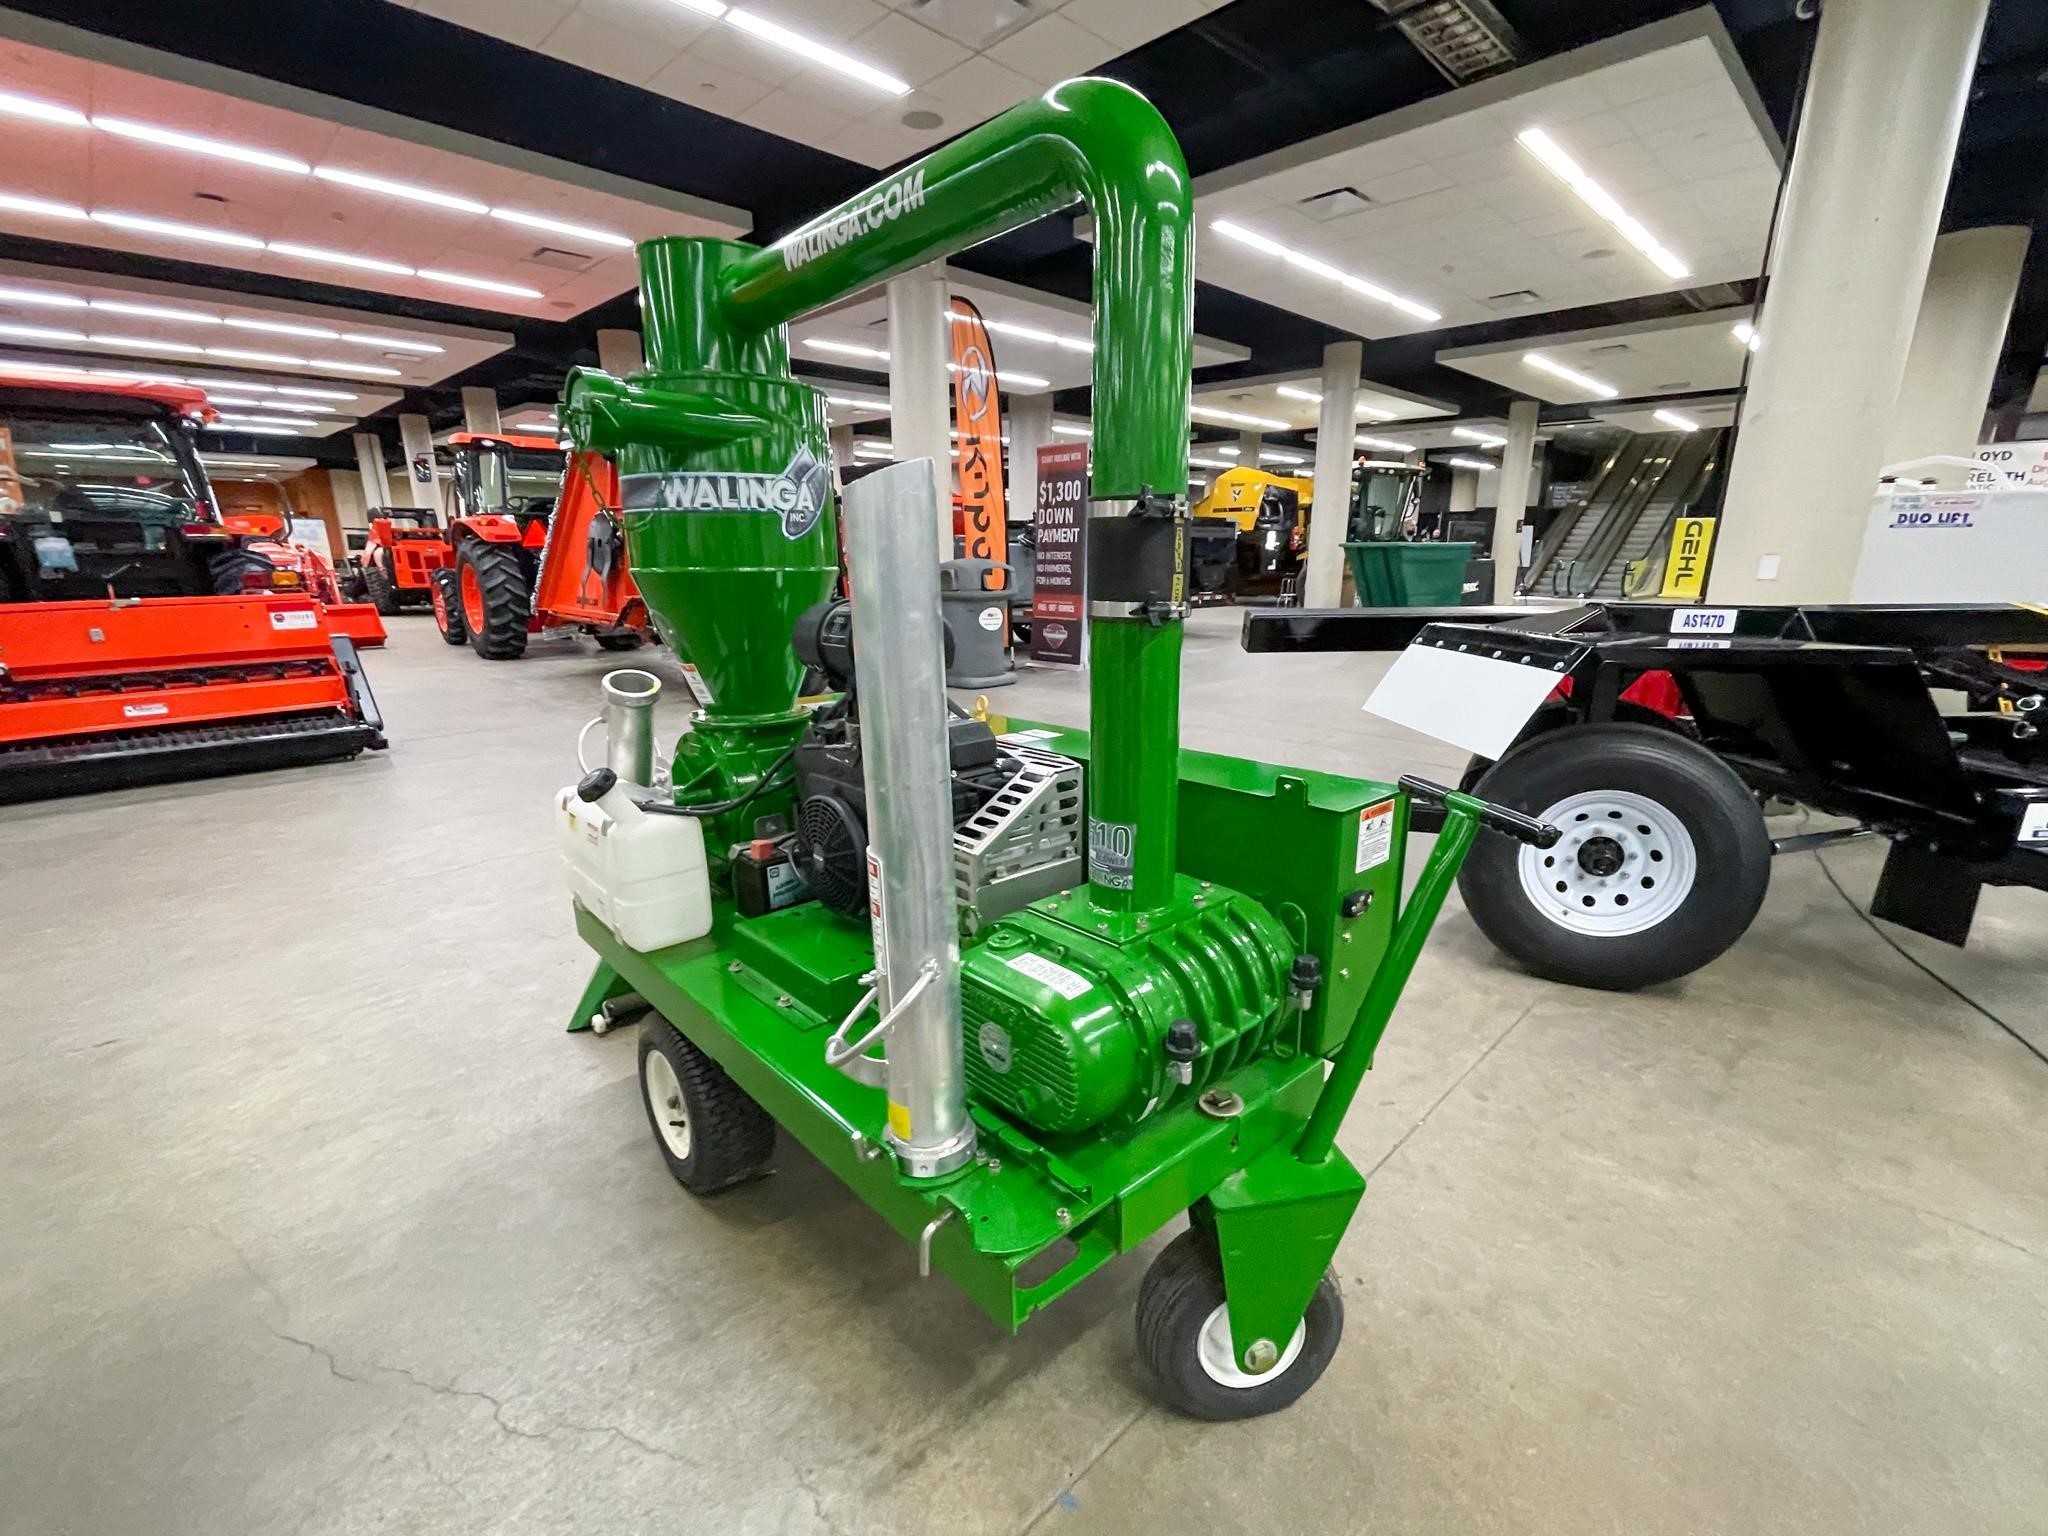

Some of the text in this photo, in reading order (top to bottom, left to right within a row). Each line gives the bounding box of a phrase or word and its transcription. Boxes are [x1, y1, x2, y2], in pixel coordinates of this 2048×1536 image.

[783, 168, 925, 272] WALINGA.COM
[664, 477, 815, 512] WALINGA
[1040, 480, 1081, 505] $1,300
[790, 512, 806, 522] INC.
[1039, 507, 1074, 525] DOWN
[1897, 513, 1970, 524] DUO LIFT
[1037, 528, 1080, 543] PAYMENT
[1036, 552, 1045, 560] NO
[1674, 521, 1703, 588] GEHL
[1036, 564, 1044, 573] NO
[1683, 615, 1725, 628] AST47D
